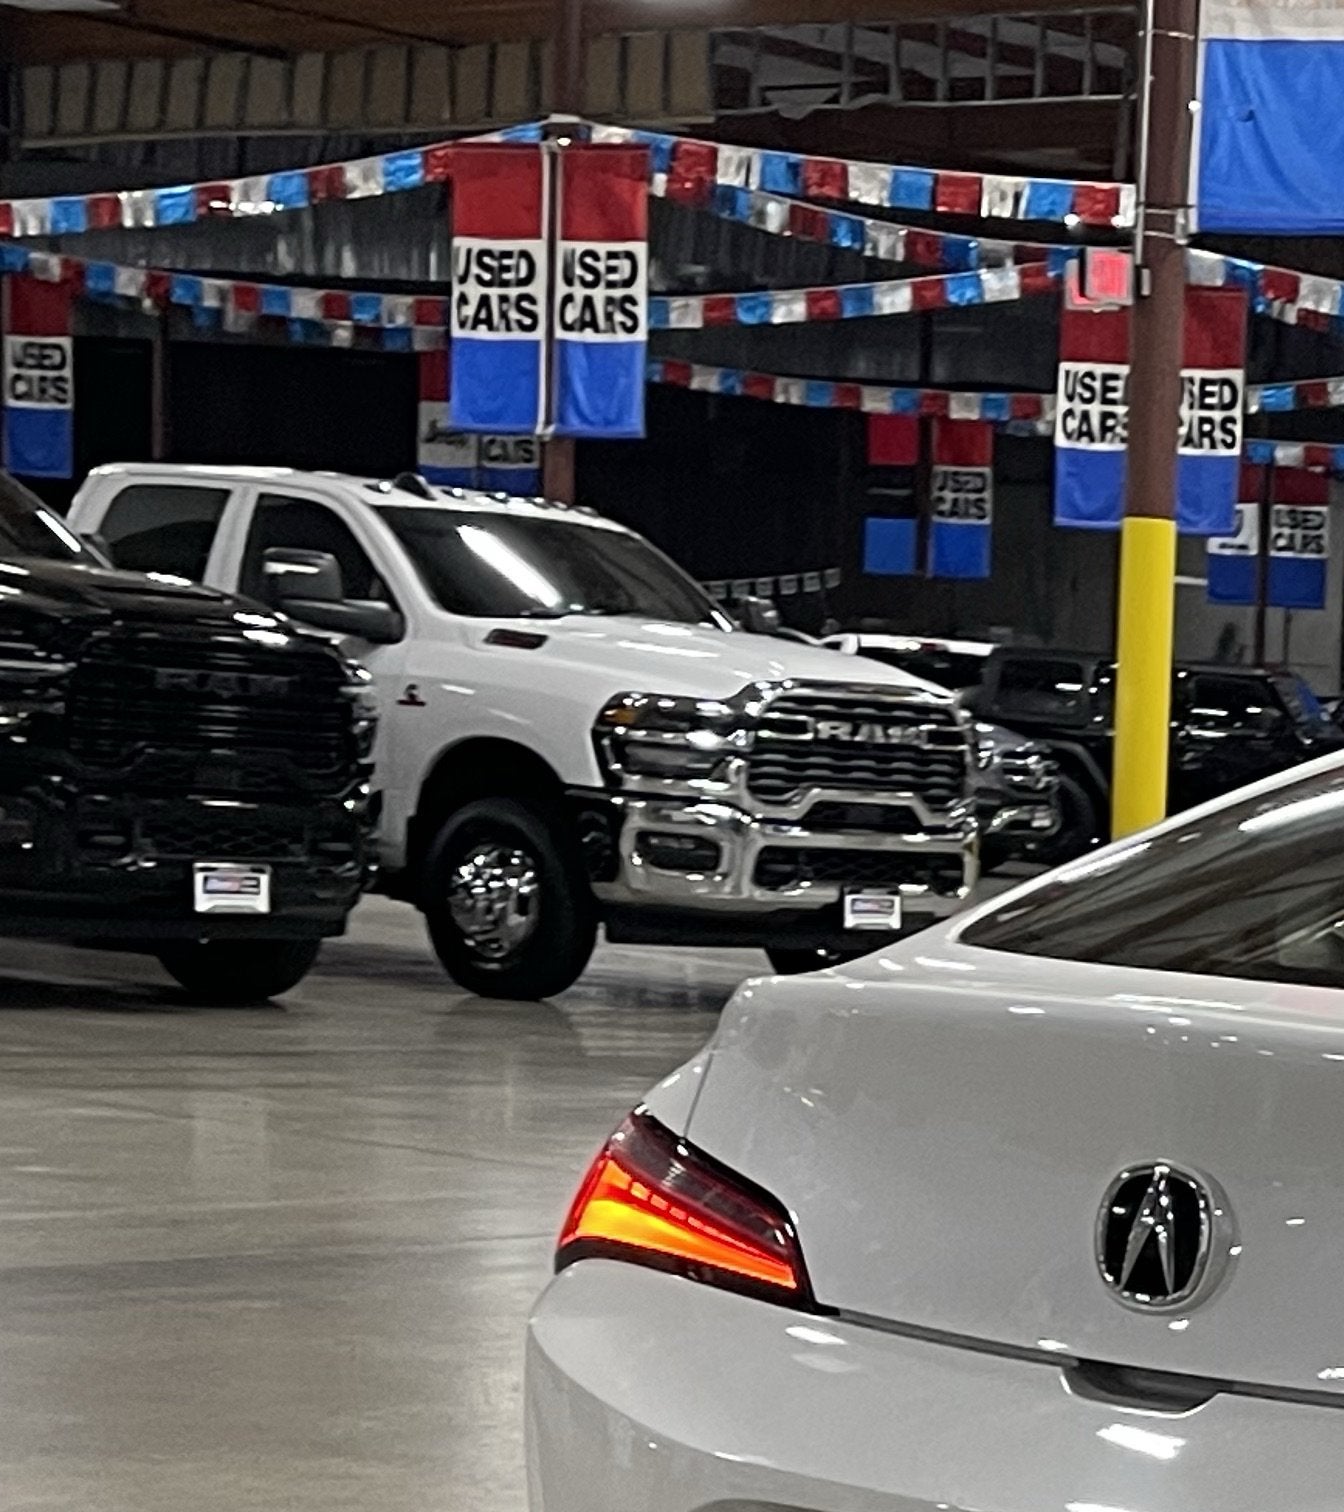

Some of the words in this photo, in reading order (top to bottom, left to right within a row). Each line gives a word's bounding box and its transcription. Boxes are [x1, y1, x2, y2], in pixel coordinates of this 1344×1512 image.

[453, 248, 537, 288] USED
[563, 248, 638, 289] USED
[457, 291, 539, 332] CARS
[559, 293, 640, 333] CARS
[12, 341, 67, 371] USED
[10, 373, 68, 404] CARS
[1065, 370, 1127, 405] USE
[1181, 377, 1239, 411] SED
[1180, 415, 1238, 449] ARS
[938, 471, 986, 494] USED
[1275, 509, 1325, 530] USED
[1273, 532, 1324, 554] CARS
